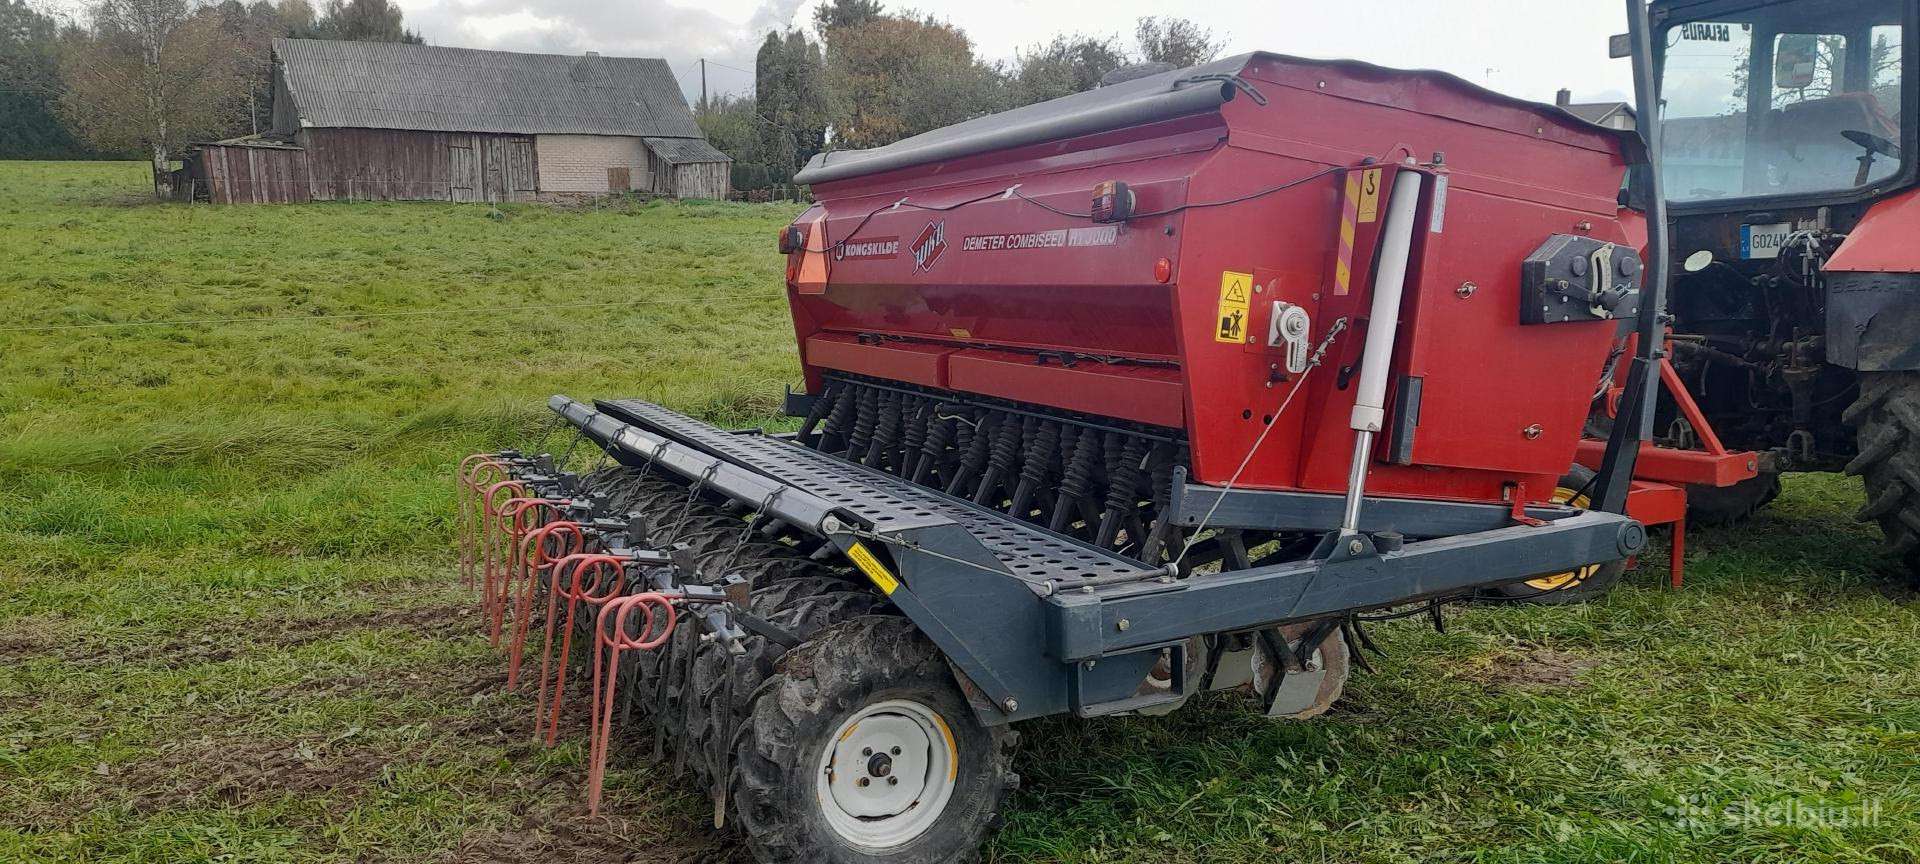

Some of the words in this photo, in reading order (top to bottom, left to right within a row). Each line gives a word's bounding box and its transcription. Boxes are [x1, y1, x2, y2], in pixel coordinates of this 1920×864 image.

[845, 240, 900, 257] KONGSKILDE
[963, 235, 1005, 251] DEMETER
[1006, 230, 1067, 249] COMBISEED
